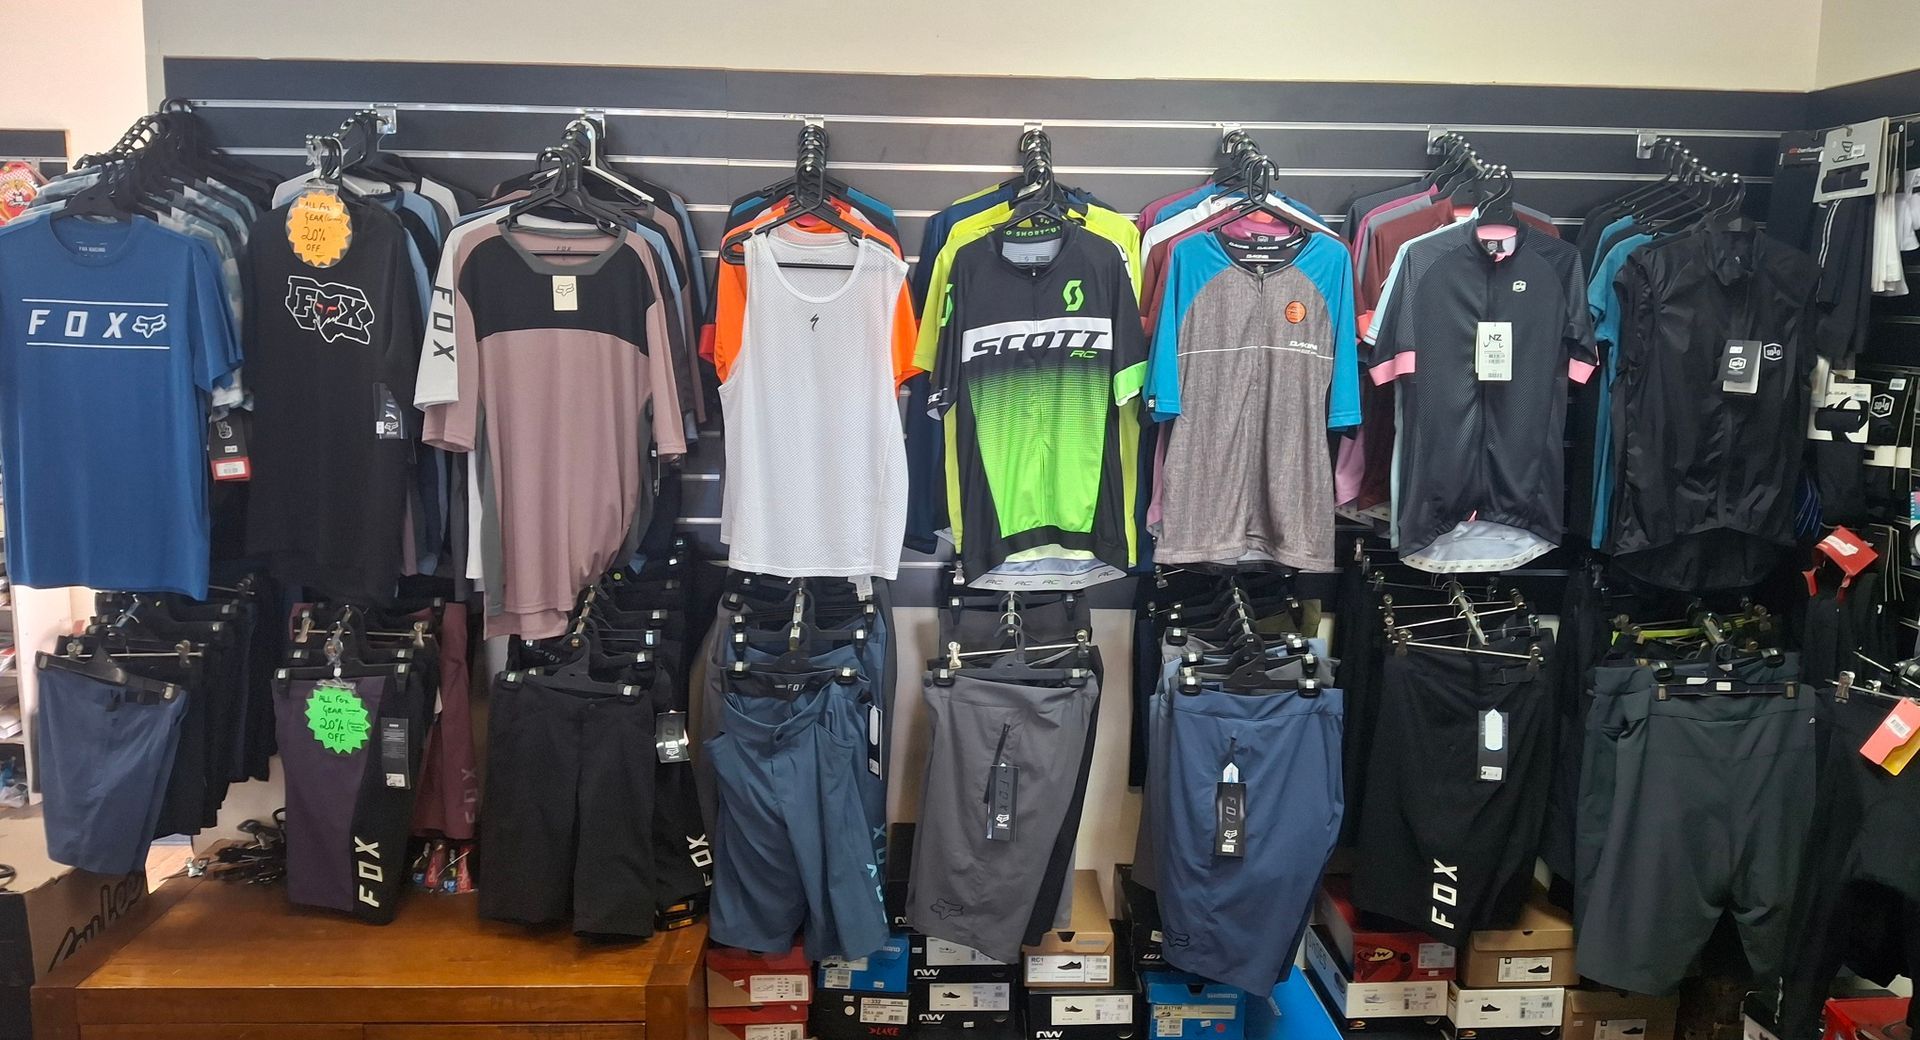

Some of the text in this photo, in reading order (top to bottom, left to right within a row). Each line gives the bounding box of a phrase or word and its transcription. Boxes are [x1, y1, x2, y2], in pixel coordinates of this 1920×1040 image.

[301, 226, 326, 242] 20%
[306, 243, 321, 253] OFF
[28, 309, 128, 339] FOX
[432, 284, 456, 362] FOX
[972, 329, 1108, 359] SCOTT
[1069, 350, 1098, 359] RC
[1097, 569, 1116, 579] RC
[319, 718, 344, 732] 20%
[327, 732, 346, 743] OFF
[354, 836, 384, 908] FOX
[1431, 858, 1458, 930] FOX
